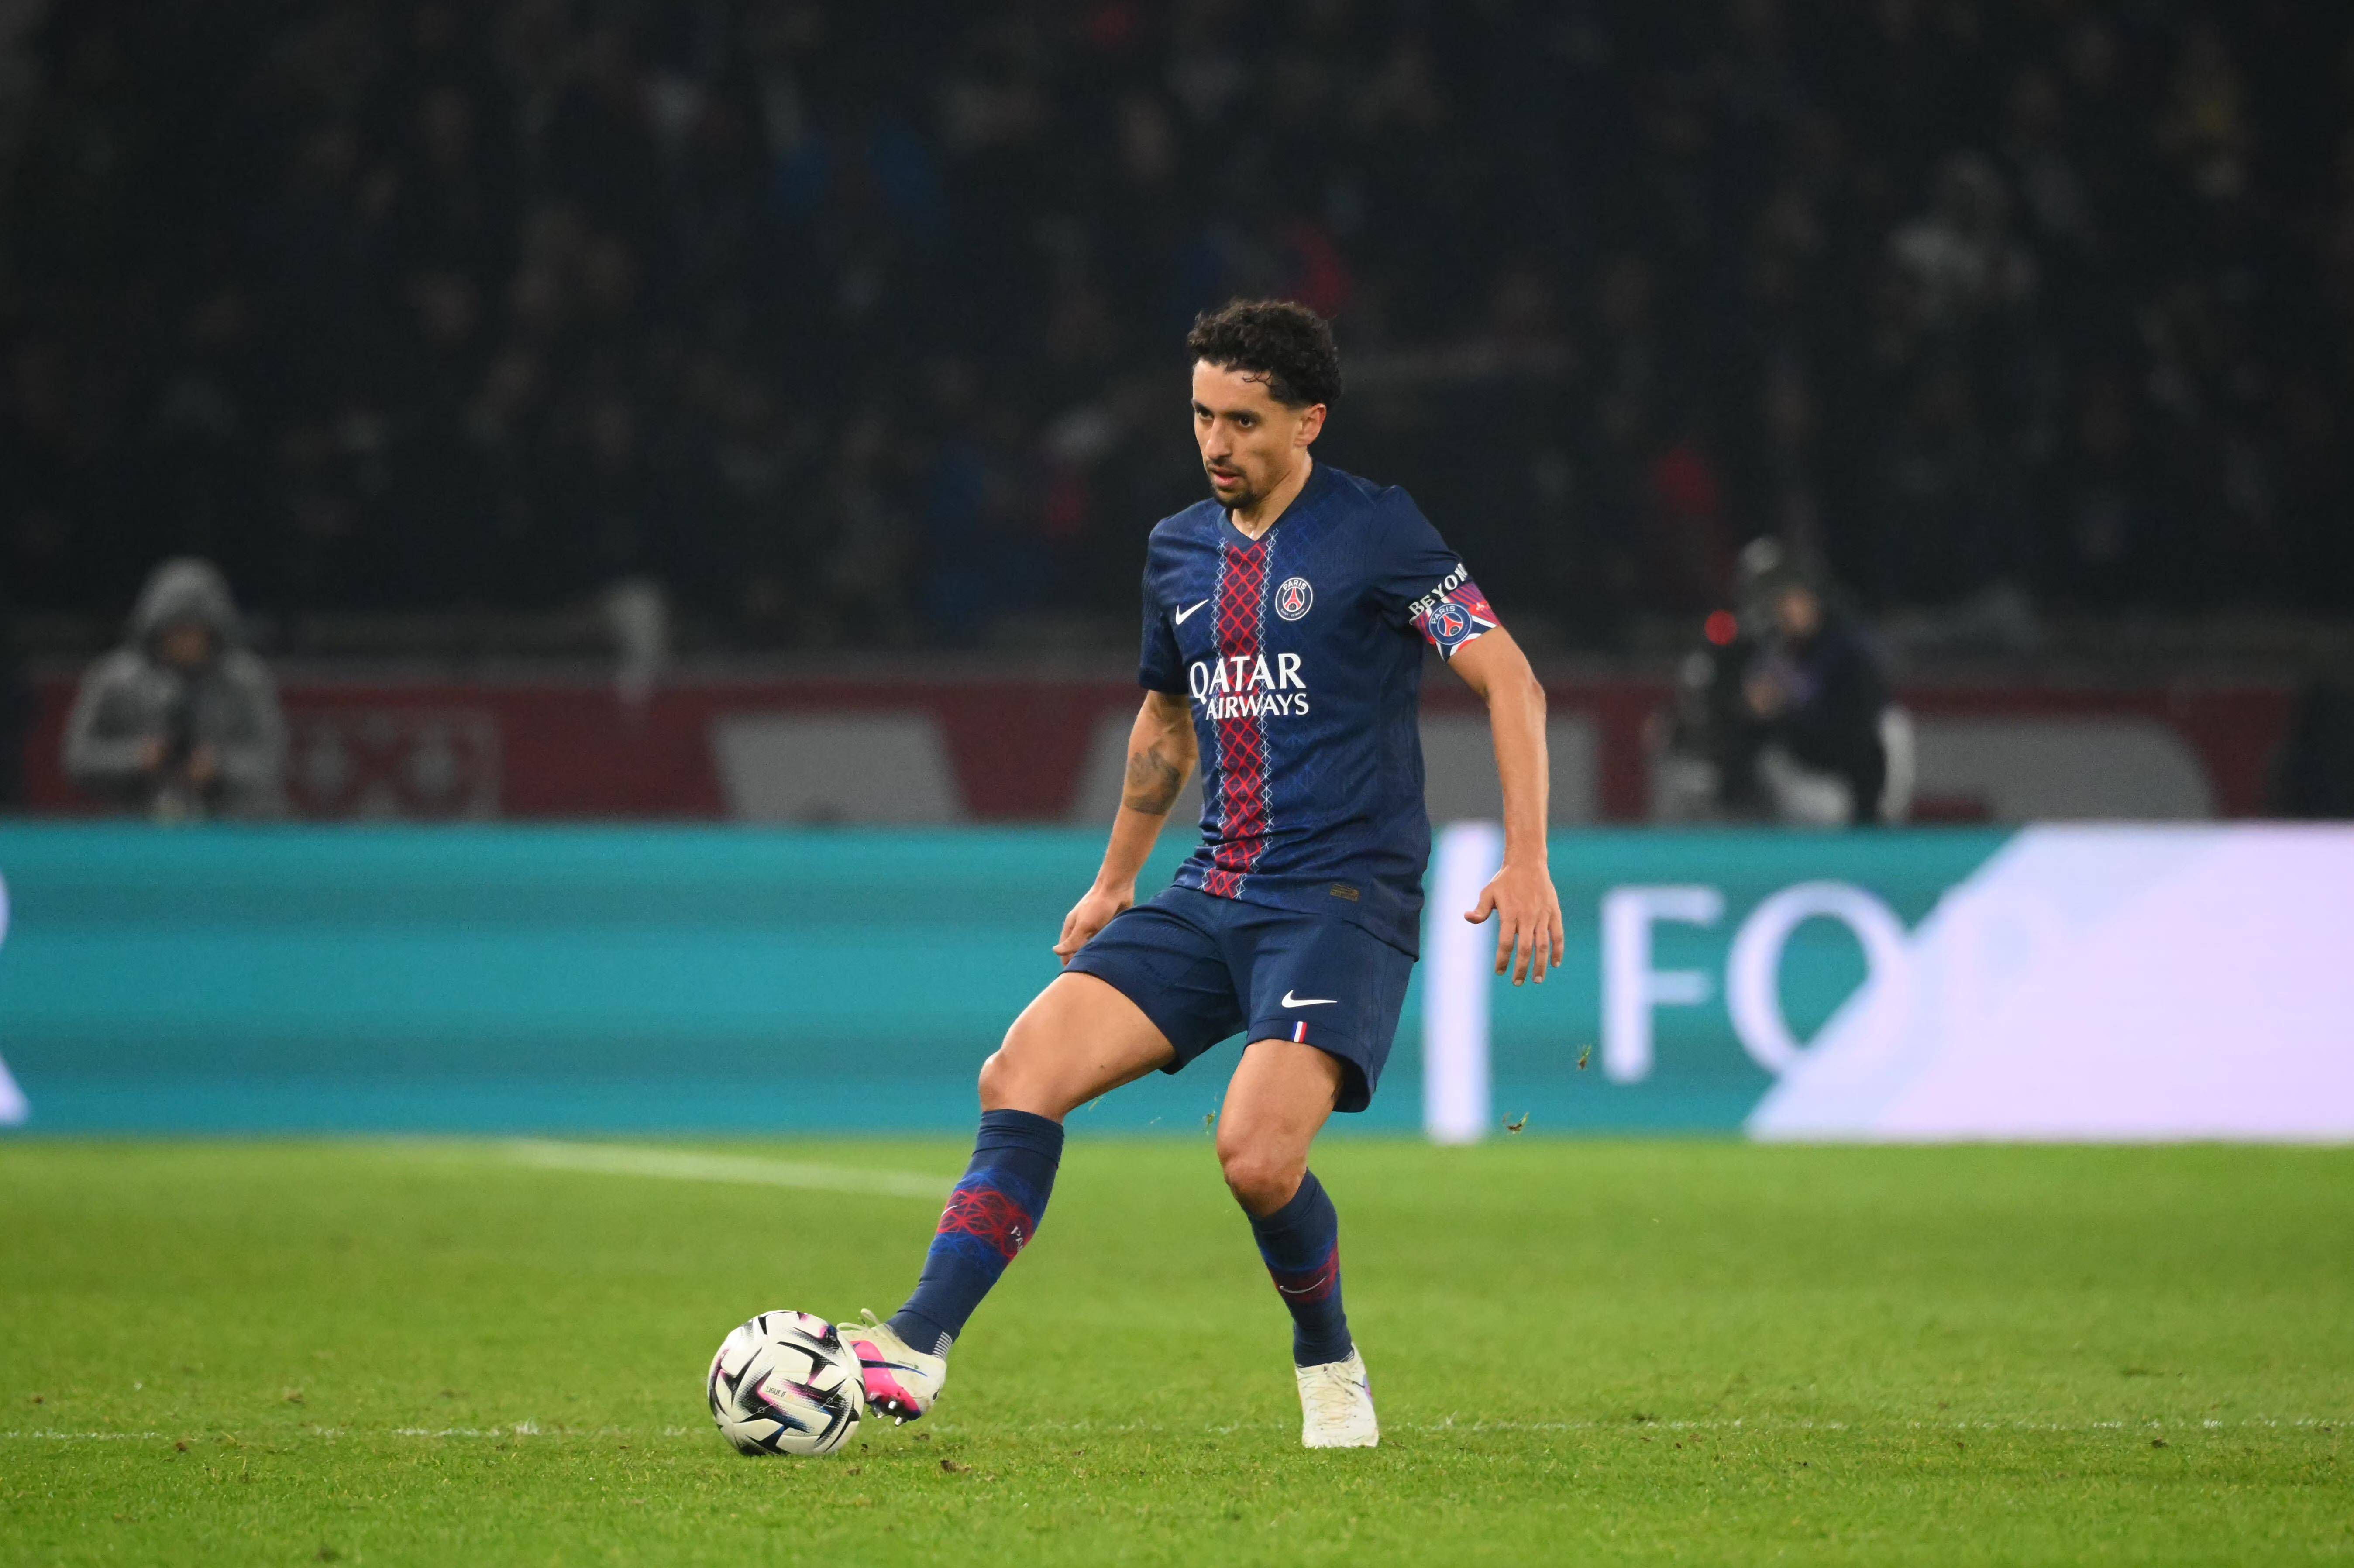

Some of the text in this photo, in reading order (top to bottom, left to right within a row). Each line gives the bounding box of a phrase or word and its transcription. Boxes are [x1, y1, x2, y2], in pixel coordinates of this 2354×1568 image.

[1283, 579, 1307, 590] PARIS
[1431, 605, 1456, 624] PARIS
[1190, 653, 1307, 705] QATAR
[1205, 693, 1309, 720] AIRWAYS
[1599, 878, 2048, 1085] FO
[766, 1386, 781, 1396] LIGUE
